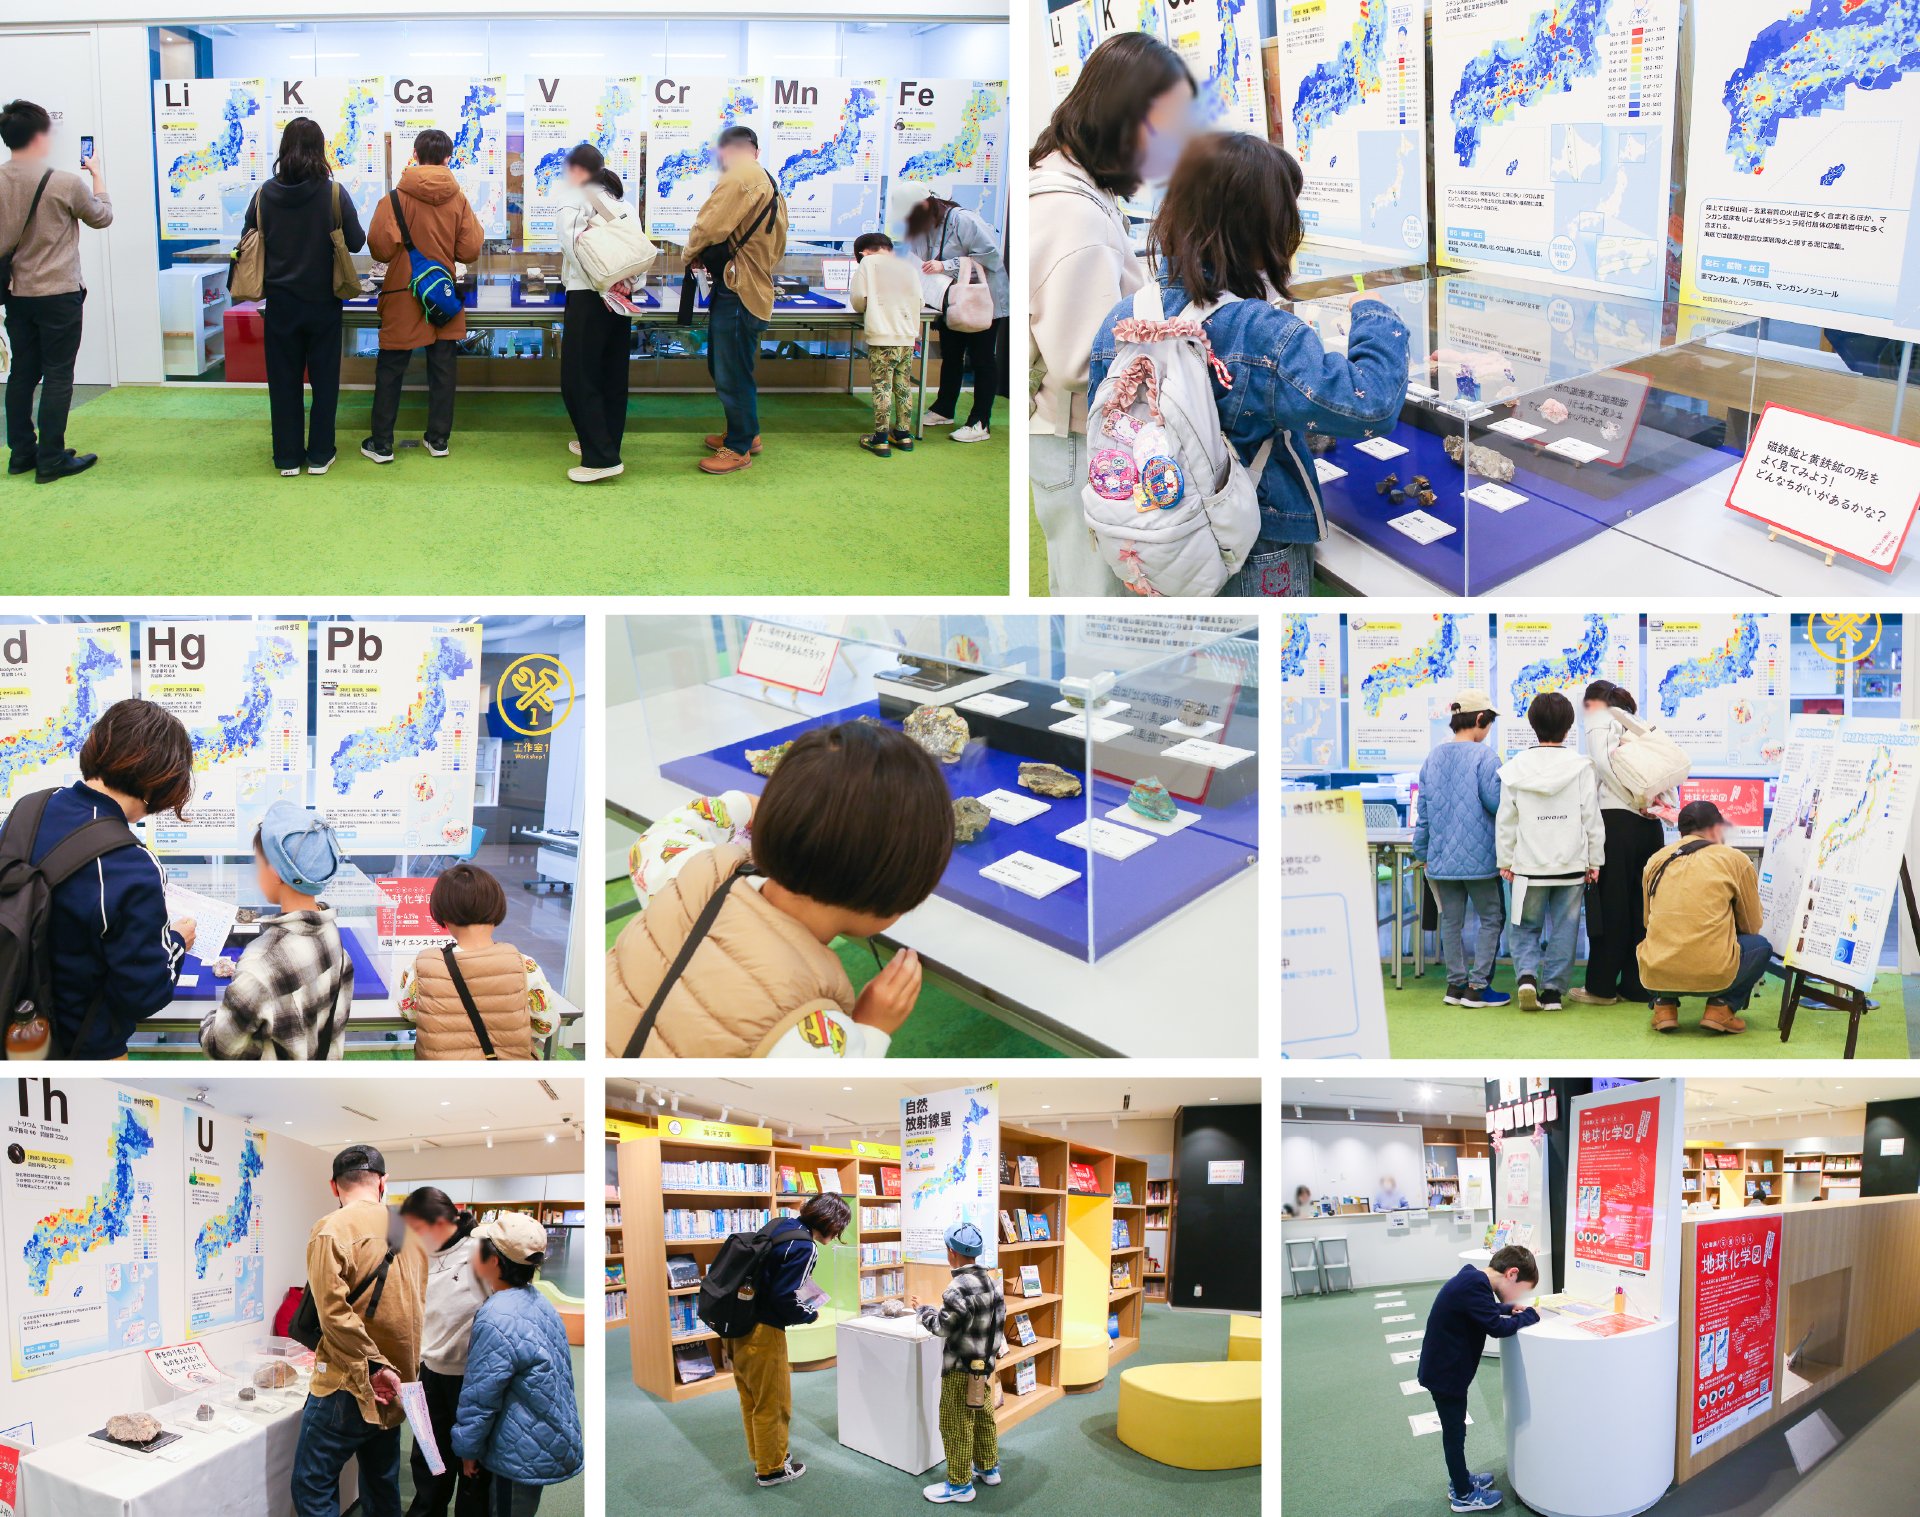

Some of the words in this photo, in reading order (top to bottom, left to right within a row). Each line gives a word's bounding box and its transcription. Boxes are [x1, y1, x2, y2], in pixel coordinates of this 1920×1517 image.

[1050, 16, 1063, 48] Li
[165, 83, 190, 107] Li
[283, 81, 304, 105] K
[394, 79, 433, 104] Ca
[538, 79, 560, 102] V
[655, 79, 691, 104] Cr
[775, 80, 818, 105] Mn
[899, 81, 934, 106] Fe
[1704, 222, 1731, 230] 含まれる。
[1705, 258, 1766, 274] 岩石・鉱物・鉱石
[1760, 455, 1835, 488] よく見てみよう！
[1766, 440, 1880, 485] 磁鉄鉱と黄鉄鉱の形を
[1755, 468, 1887, 523] どんなちがいがあるかな？
[4, 630, 28, 664] d
[148, 627, 205, 670] Hg
[328, 627, 383, 661] Pb
[1840, 638, 1848, 654] 1
[530, 708, 539, 725] 1
[513, 743, 549, 752] 工作室1
[1293, 797, 1344, 813] 地球化学図
[18, 1078, 69, 1124] Th
[906, 1097, 928, 1116] 自然
[17, 1120, 36, 1129] トリウム
[198, 1116, 213, 1152] U
[905, 1111, 952, 1132] 放射線量
[1582, 1123, 1634, 1143] 地球化学図
[1701, 1245, 1761, 1275] 地球化学図
